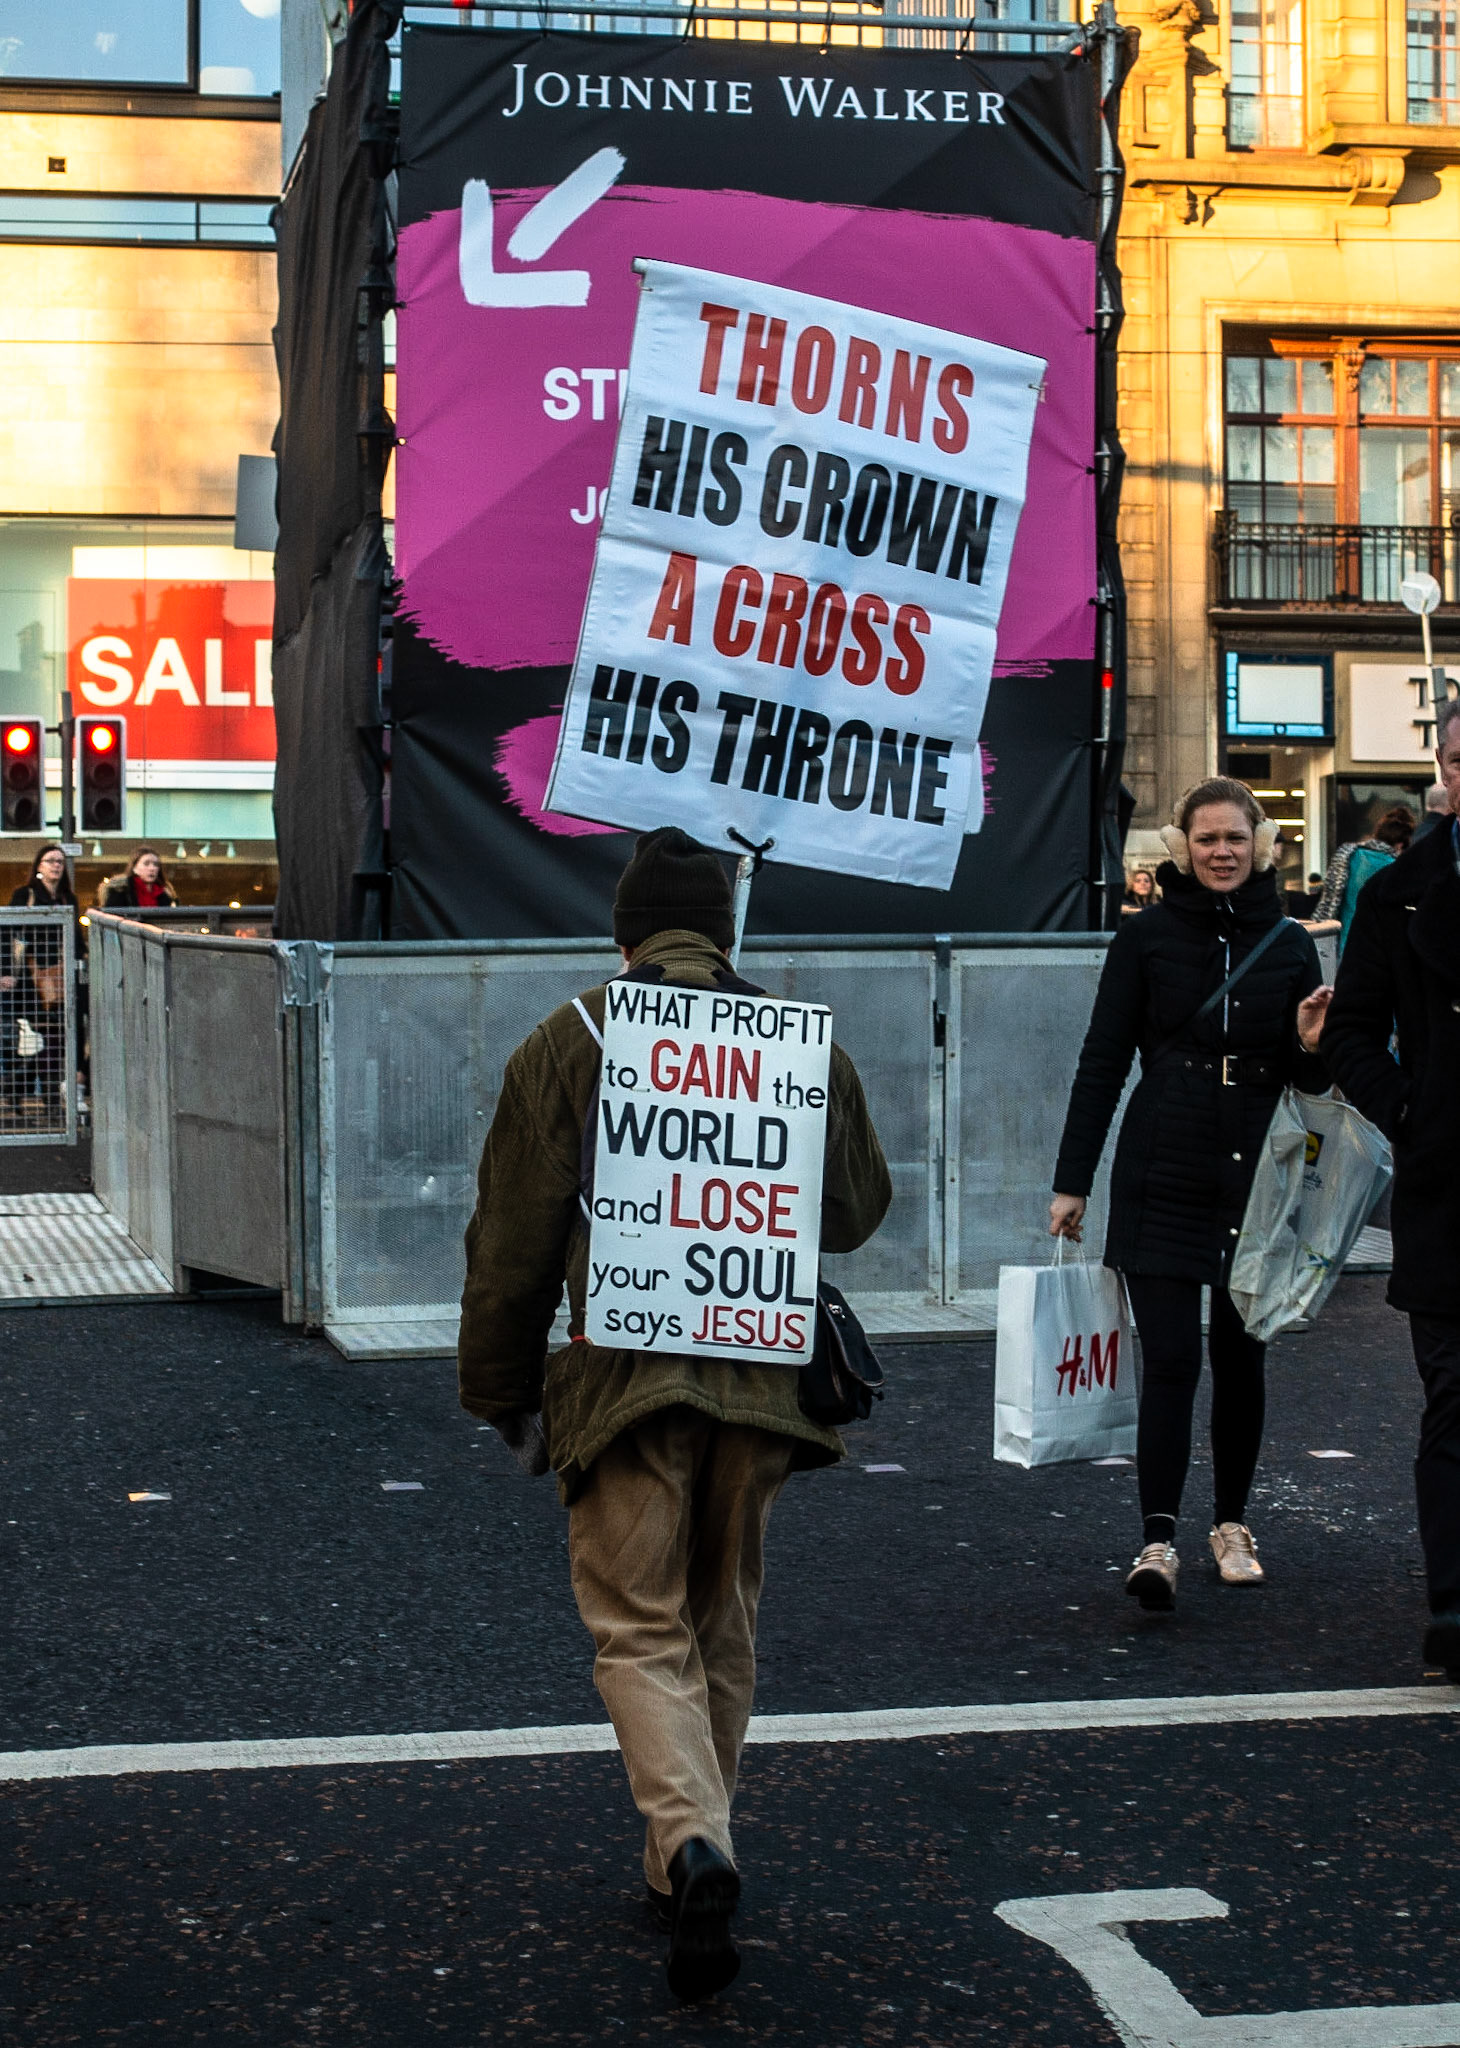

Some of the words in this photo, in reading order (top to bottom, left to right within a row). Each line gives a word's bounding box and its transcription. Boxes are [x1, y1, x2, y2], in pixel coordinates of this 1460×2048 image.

[503, 63, 753, 119] JOHNNIE
[778, 75, 1007, 126] WALKER
[700, 302, 974, 454] THORNS
[632, 415, 748, 527] HIS
[760, 443, 1000, 586] CROWN
[648, 550, 697, 645] A
[712, 565, 931, 695] CROSS
[582, 664, 699, 773] HIS
[710, 690, 953, 826] THRONE
[608, 985, 698, 1030] WHAT
[711, 998, 832, 1045] PROFIT
[605, 1059, 638, 1089] to
[650, 1039, 761, 1103] GAIN
[773, 1071, 826, 1109] the
[601, 1099, 788, 1171] WORLD
[594, 1189, 662, 1225] and
[669, 1173, 799, 1239] LOSE
[588, 1262, 669, 1298] your
[684, 1242, 815, 1307] SOUL
[604, 1308, 683, 1348] says
[692, 1304, 806, 1350] JESUS
[1055, 1329, 1120, 1397] H&M
